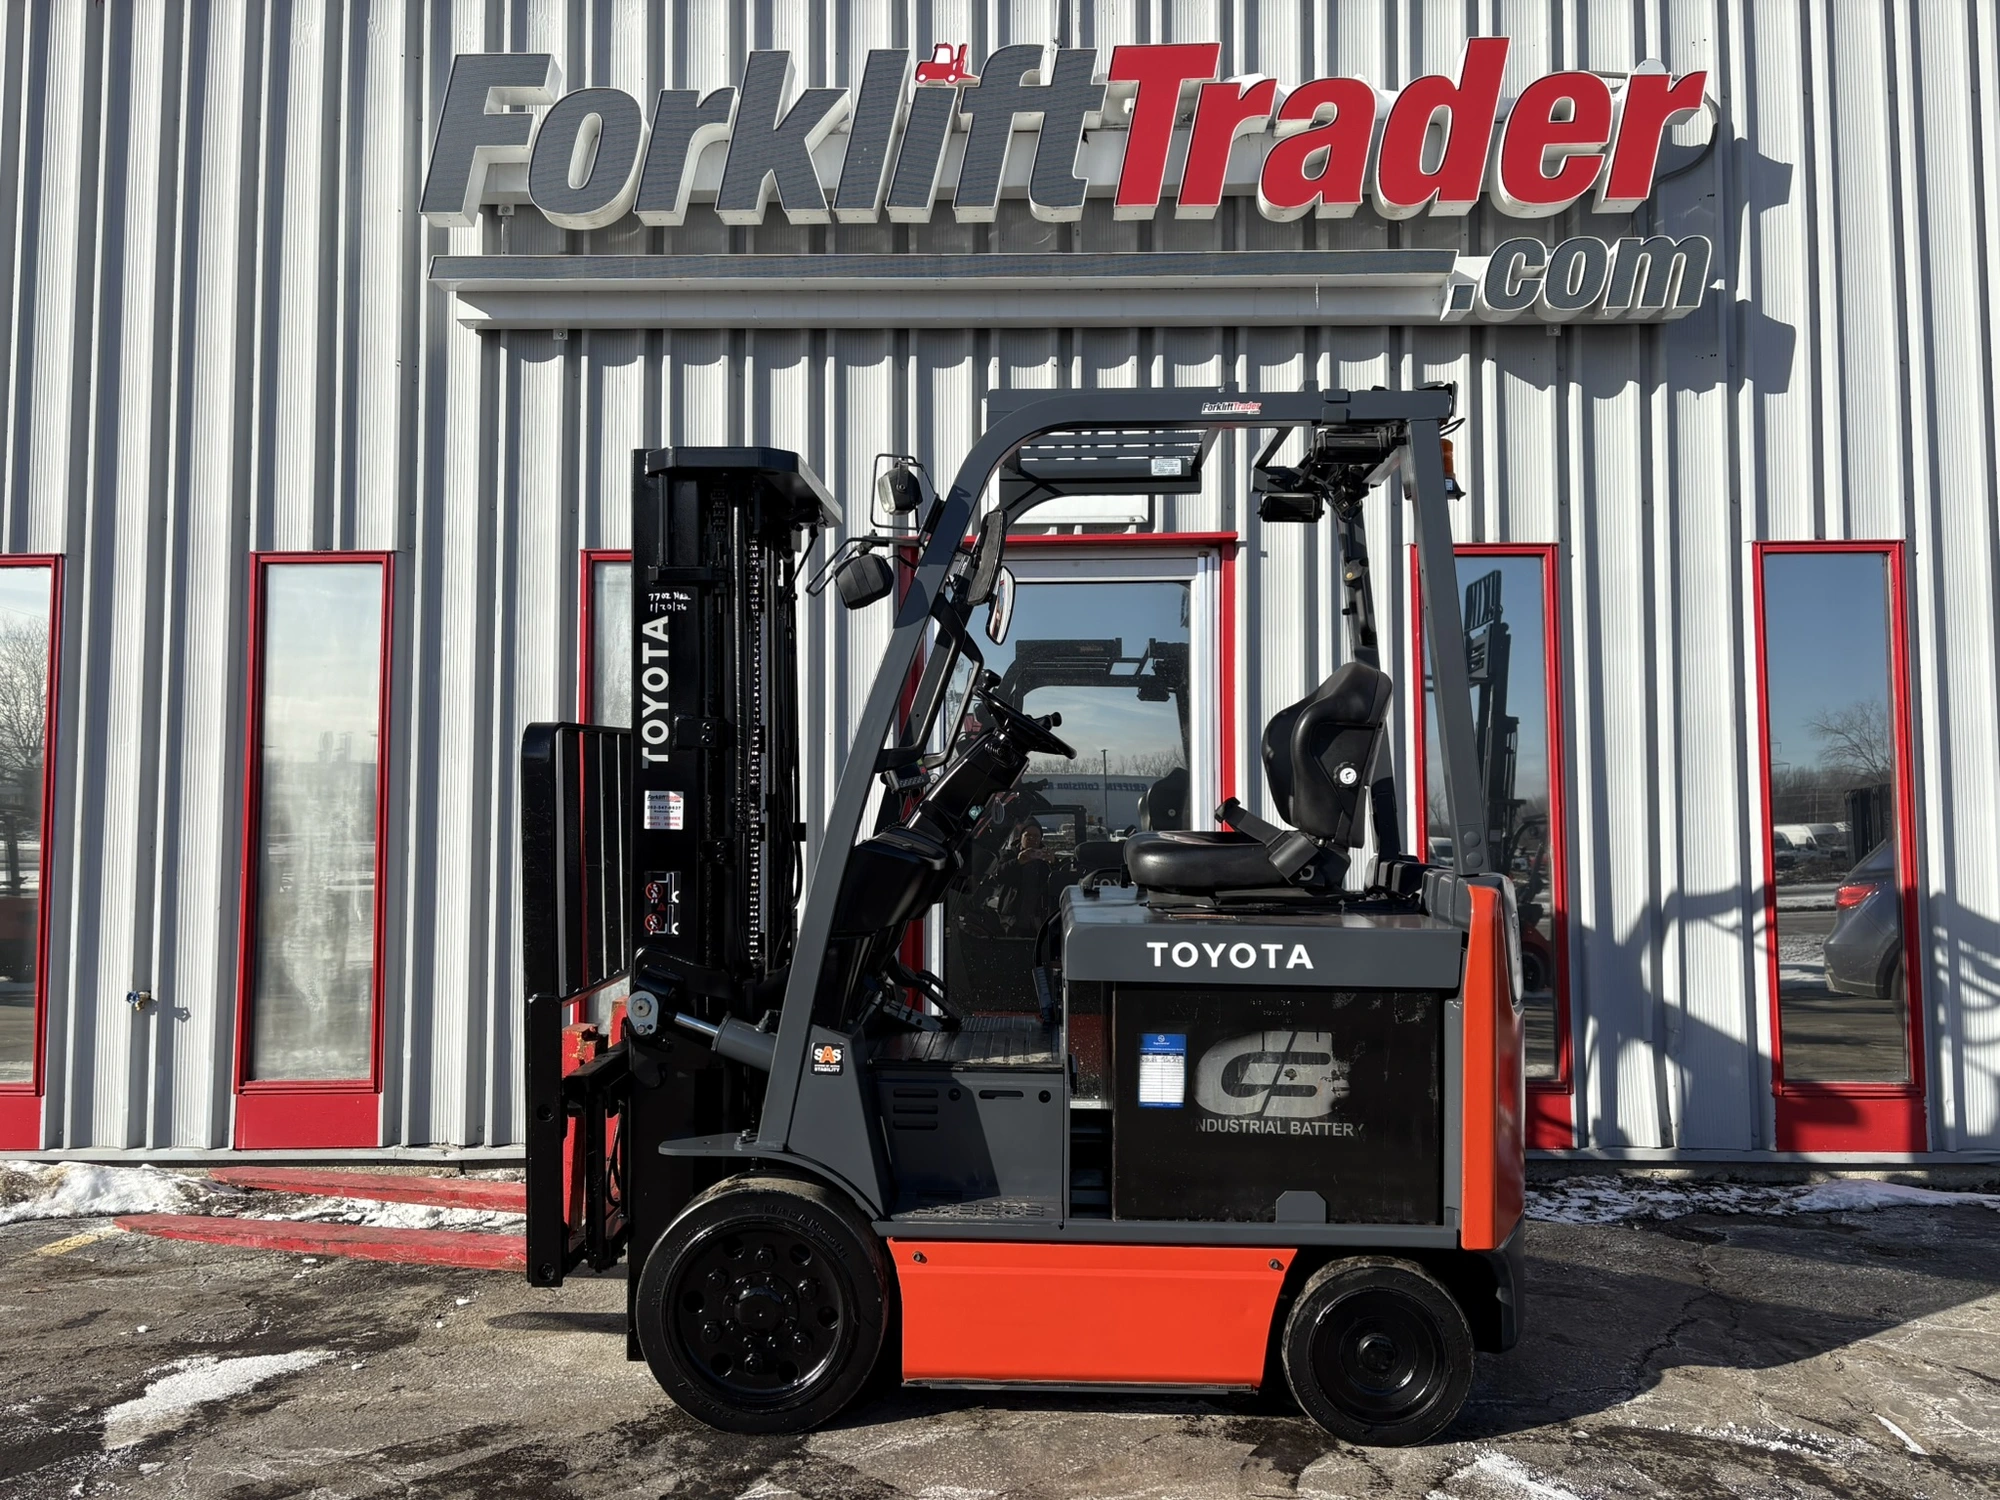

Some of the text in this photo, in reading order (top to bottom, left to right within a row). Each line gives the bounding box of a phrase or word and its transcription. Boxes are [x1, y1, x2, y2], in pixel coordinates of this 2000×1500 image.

[1442, 235, 1712, 318] .com
[642, 615, 669, 769] TOYOTA
[1146, 941, 1314, 970] TOYOTA
[814, 1046, 841, 1063] SAS
